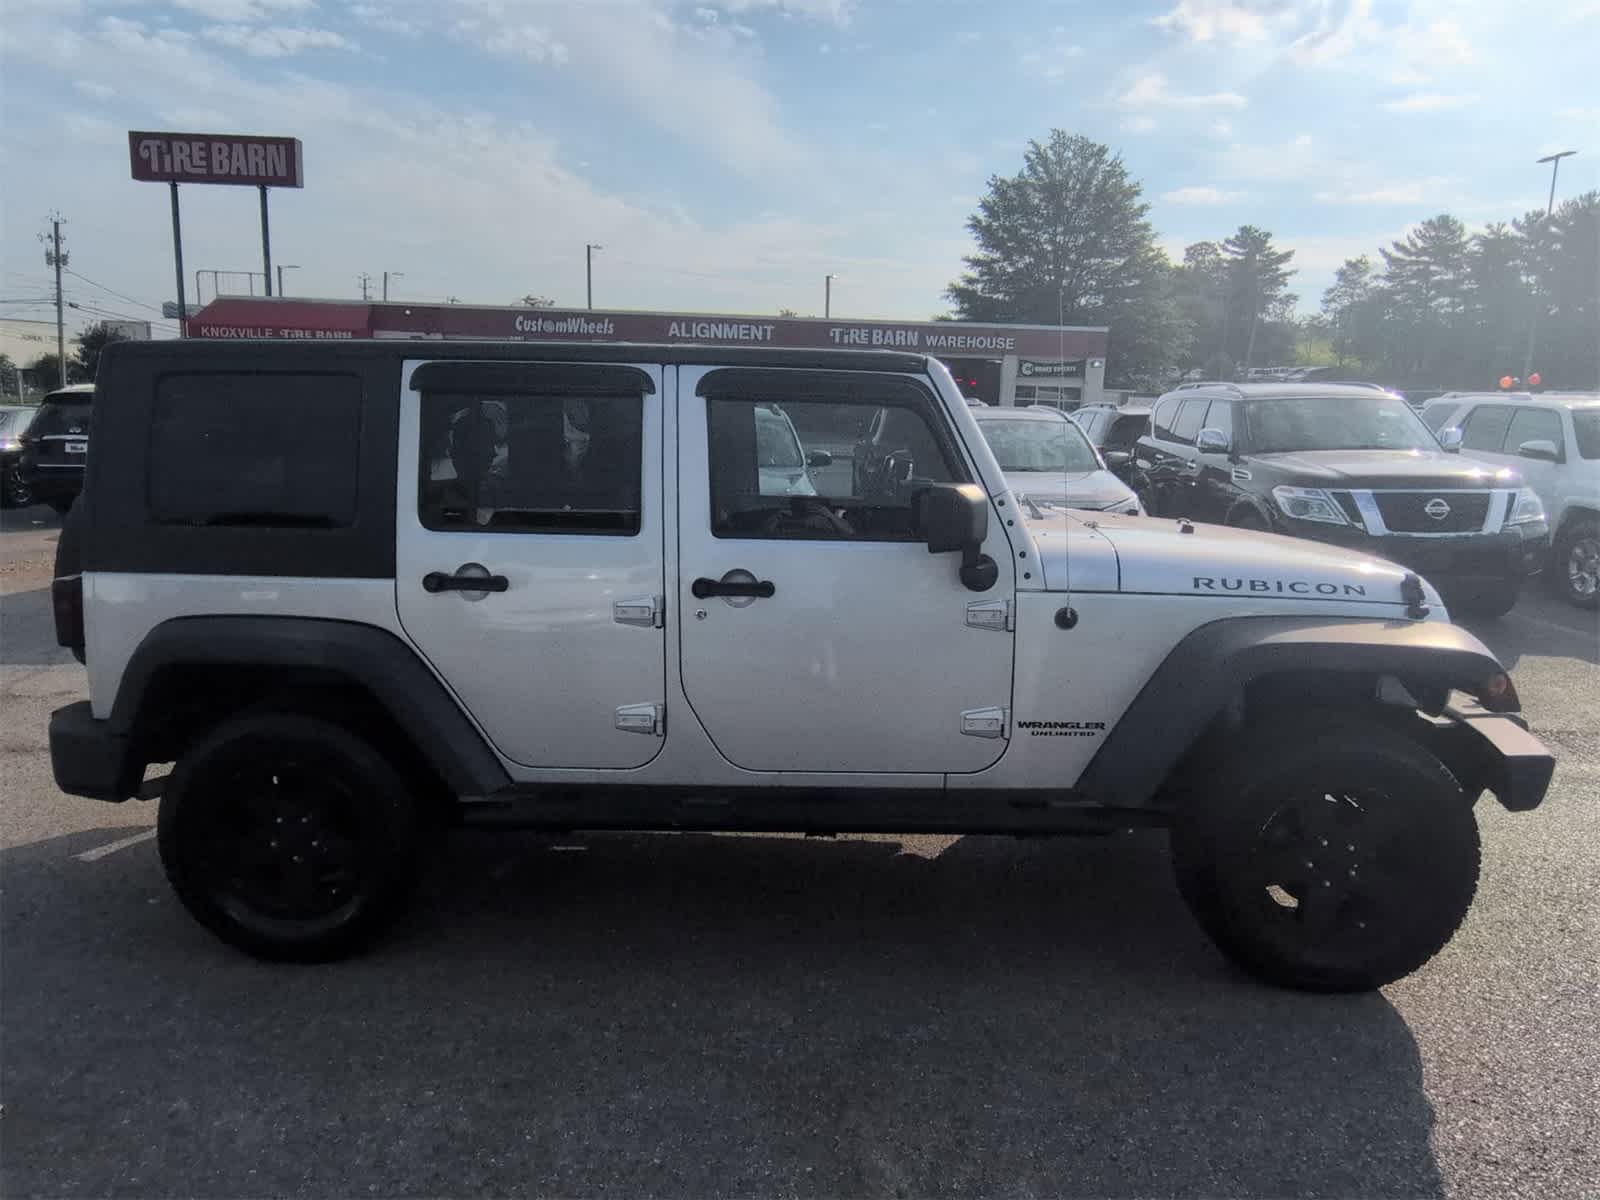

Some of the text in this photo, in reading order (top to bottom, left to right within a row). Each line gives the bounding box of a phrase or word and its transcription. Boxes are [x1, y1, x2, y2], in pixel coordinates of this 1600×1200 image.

[211, 142, 287, 176] BARN
[200, 327, 273, 338] KNOXVILLE
[668, 322, 774, 340] ALIGNMENT
[872, 329, 918, 346] BARN
[926, 335, 1015, 350] WAREHOUSE
[1194, 577, 1366, 597] RUBICON
[1017, 721, 1105, 730] WRANGLER
